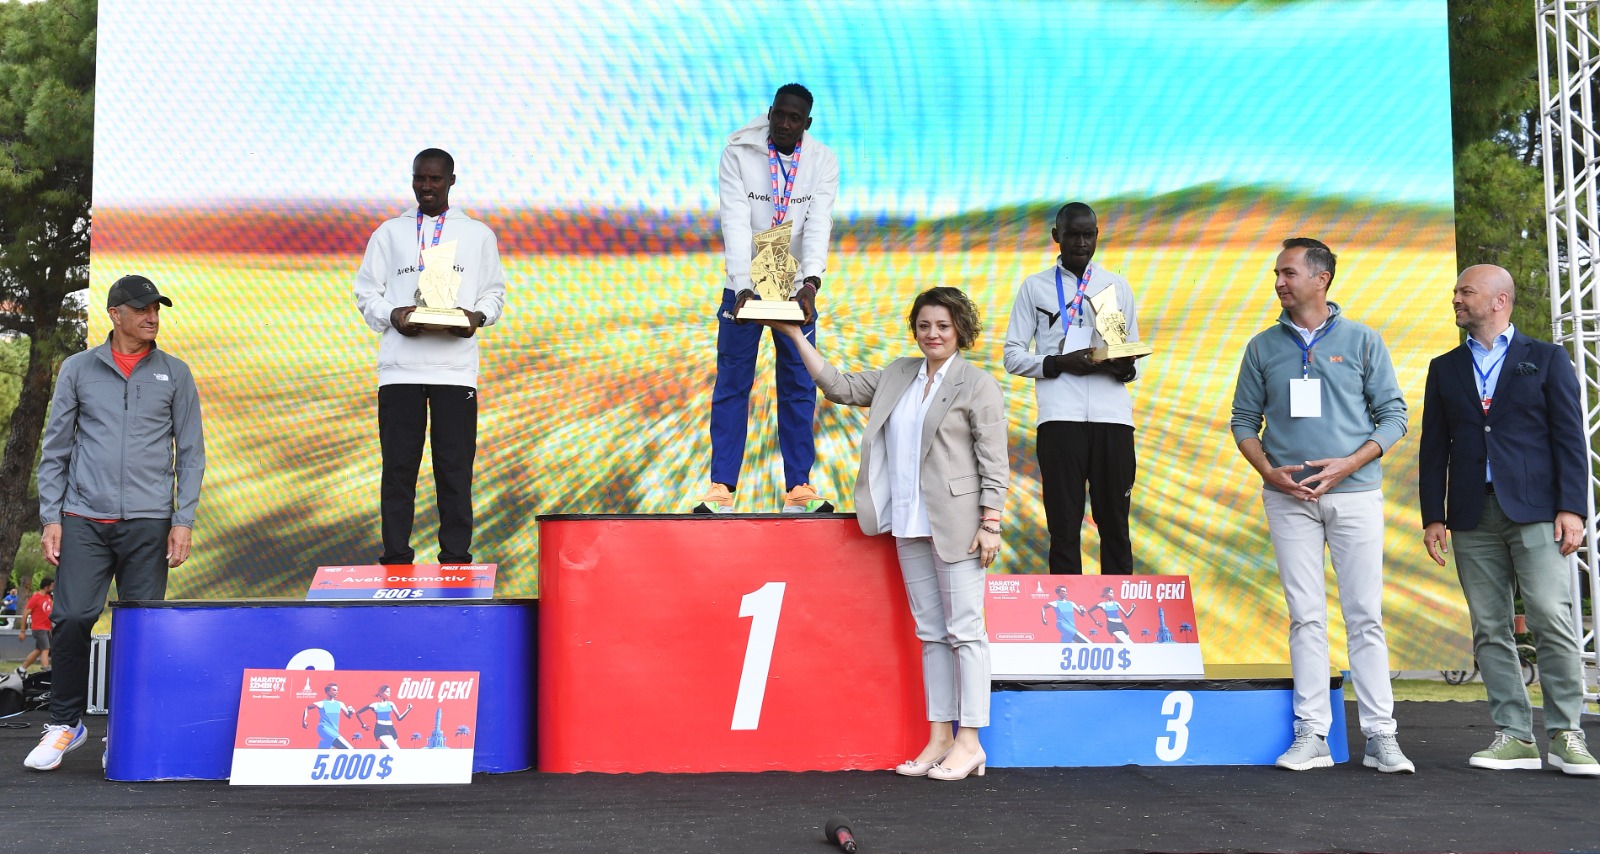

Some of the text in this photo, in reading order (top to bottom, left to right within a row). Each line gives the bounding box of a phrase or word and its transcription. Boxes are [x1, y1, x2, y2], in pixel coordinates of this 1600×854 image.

[748, 191, 771, 203] Avek
[396, 264, 416, 276] Avek
[373, 588, 410, 599] 500
[1120, 580, 1186, 602] ÖDÜL ÇEKİ
[730, 581, 787, 730] 1
[1060, 648, 1114, 670] 3.000
[397, 678, 474, 703] ÖDÜL ÇEKİ
[1155, 691, 1194, 762] 3
[311, 754, 376, 780] 5.000
